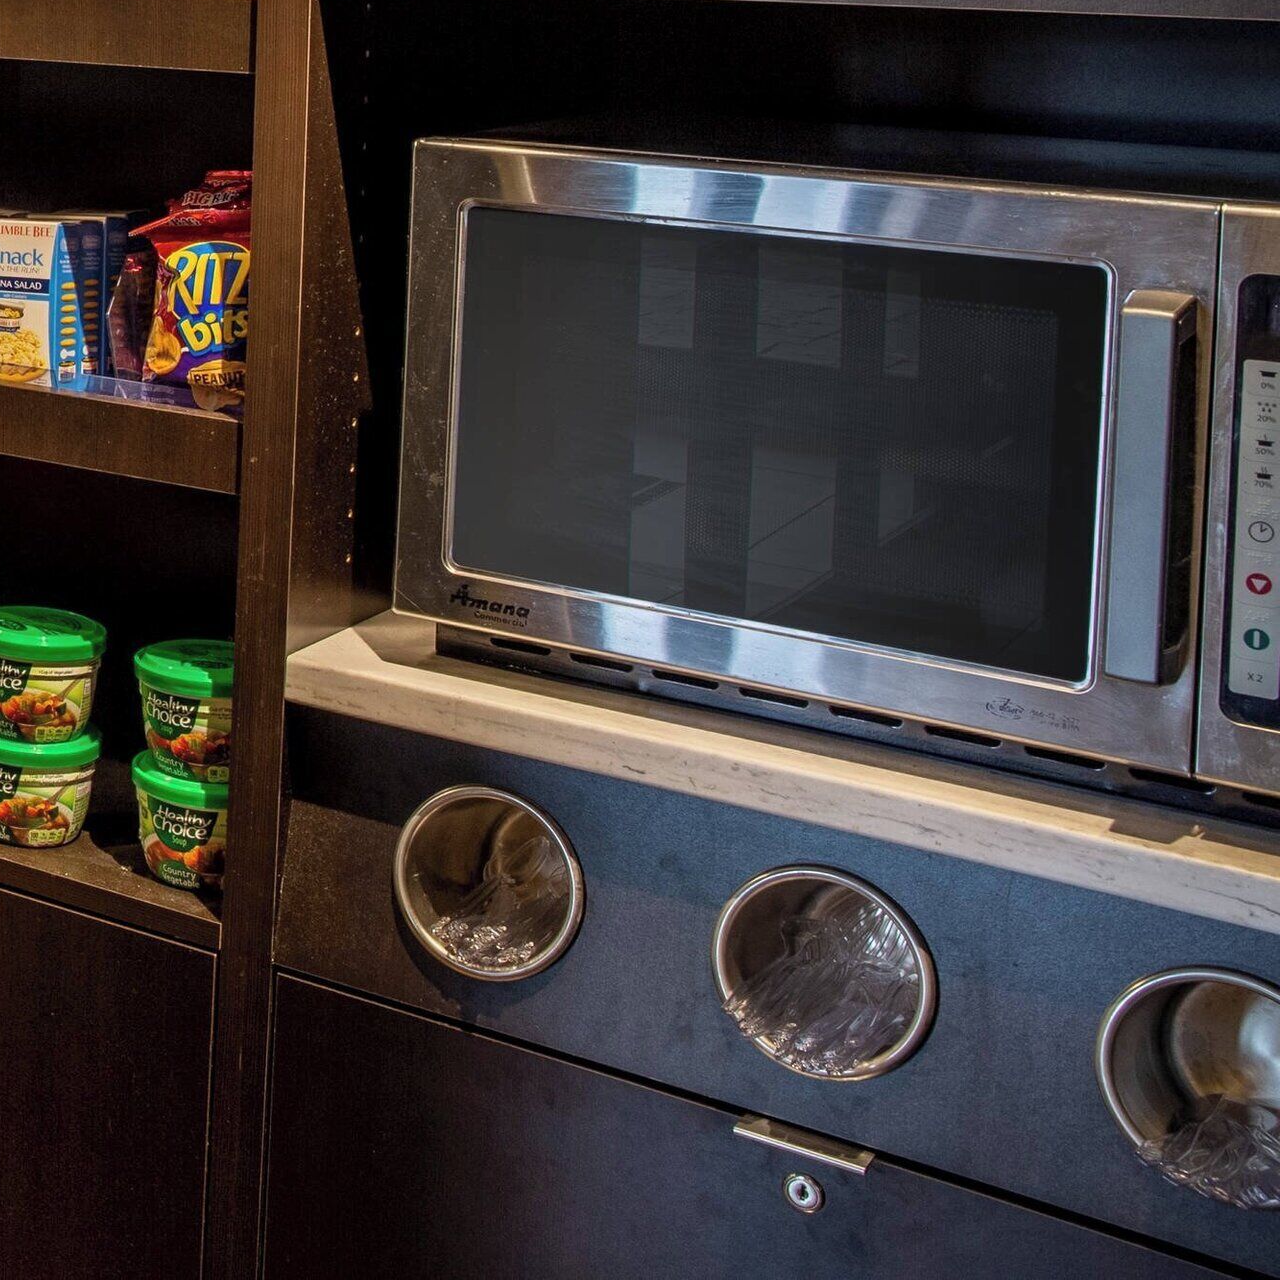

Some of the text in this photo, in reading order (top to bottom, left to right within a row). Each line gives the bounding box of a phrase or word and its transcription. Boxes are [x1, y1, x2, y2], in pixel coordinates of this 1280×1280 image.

[32, 226, 51, 238] BEE
[14, 280, 43, 291] SALAD
[167, 250, 250, 315] RITZ
[1260, 381, 1276, 391] 0%
[1256, 414, 1277, 423] 20%
[1255, 447, 1275, 457] 50%
[1254, 480, 1274, 489] 70%
[450, 583, 531, 619] Amana
[147, 692, 196, 716] Healthy
[146, 704, 192, 729] Choice
[157, 803, 213, 829] Healthy
[153, 815, 208, 840] Choice
